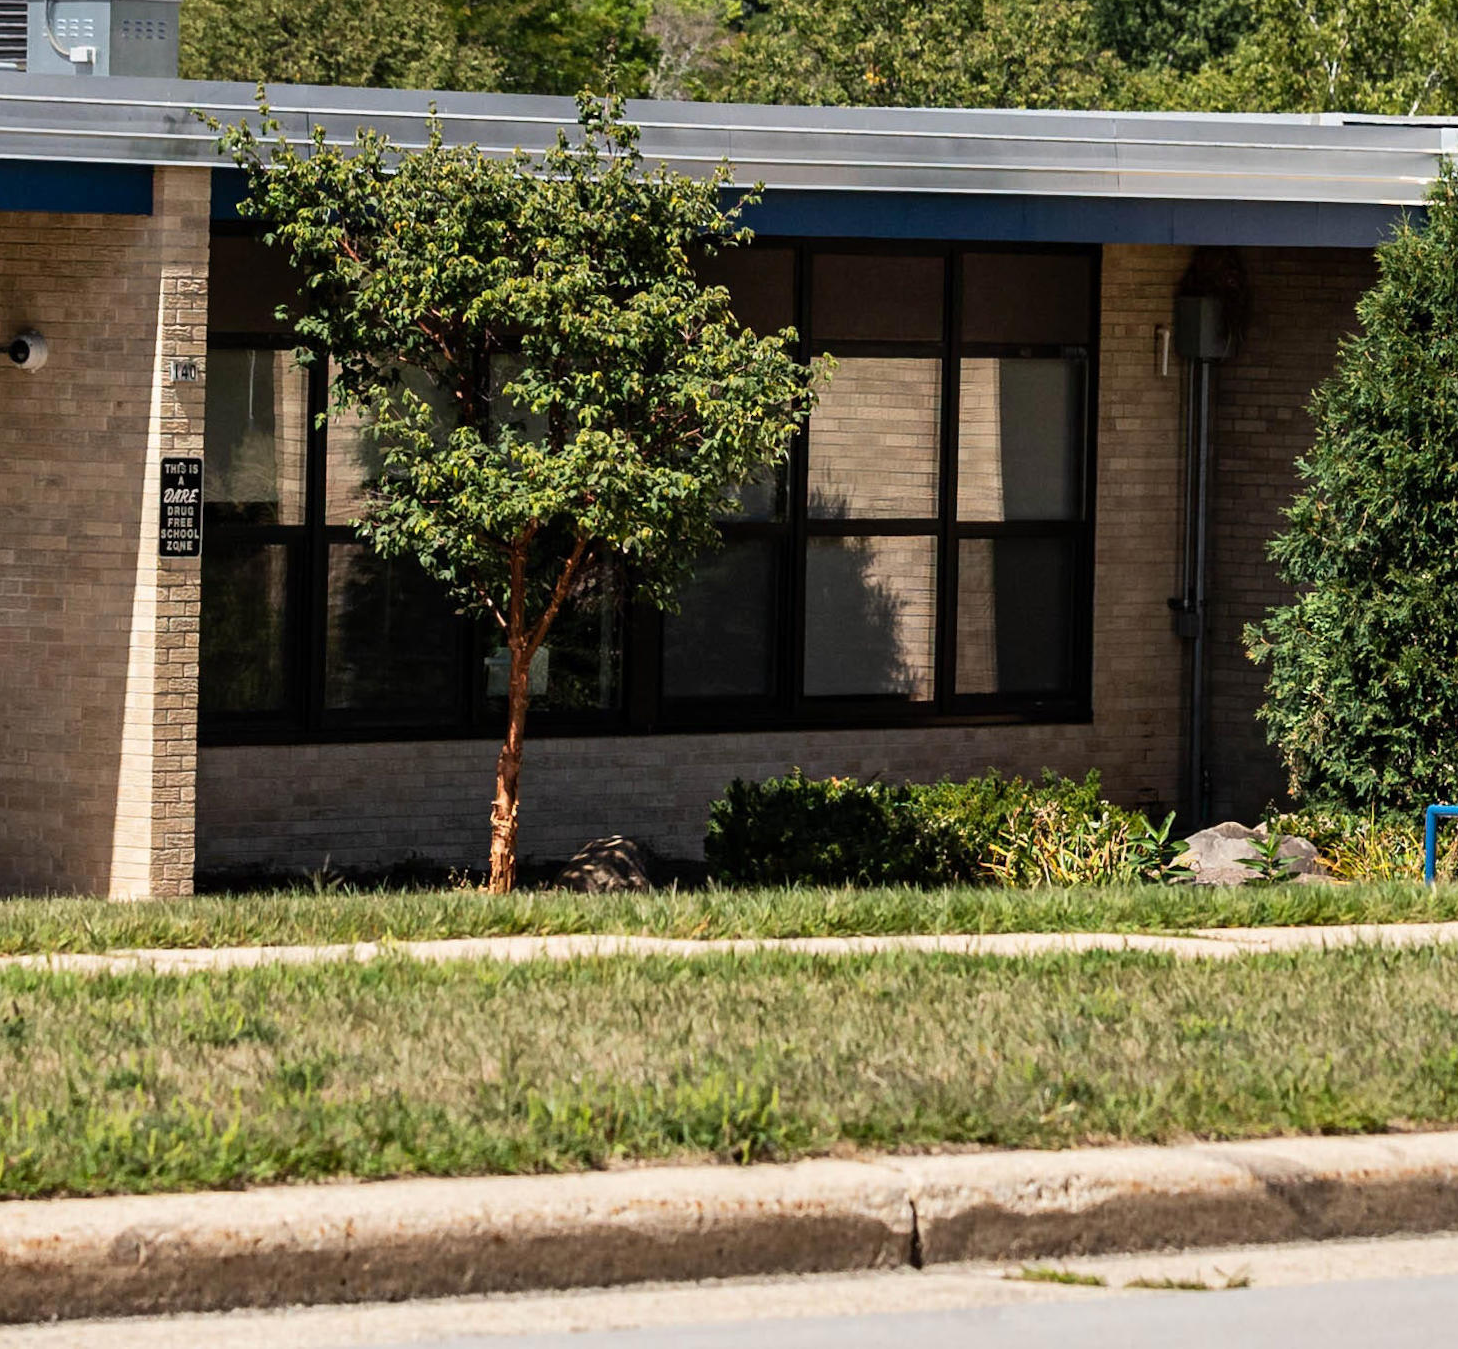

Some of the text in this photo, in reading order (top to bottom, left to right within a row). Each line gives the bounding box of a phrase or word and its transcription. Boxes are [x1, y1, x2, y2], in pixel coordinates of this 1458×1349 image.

[164, 463, 199, 475] THIS IS
[177, 475, 185, 486] A
[167, 506, 194, 517] DRUG
[167, 517, 193, 528] FREE
[160, 528, 200, 539] SCHOOL
[166, 540, 193, 552] ZONE
